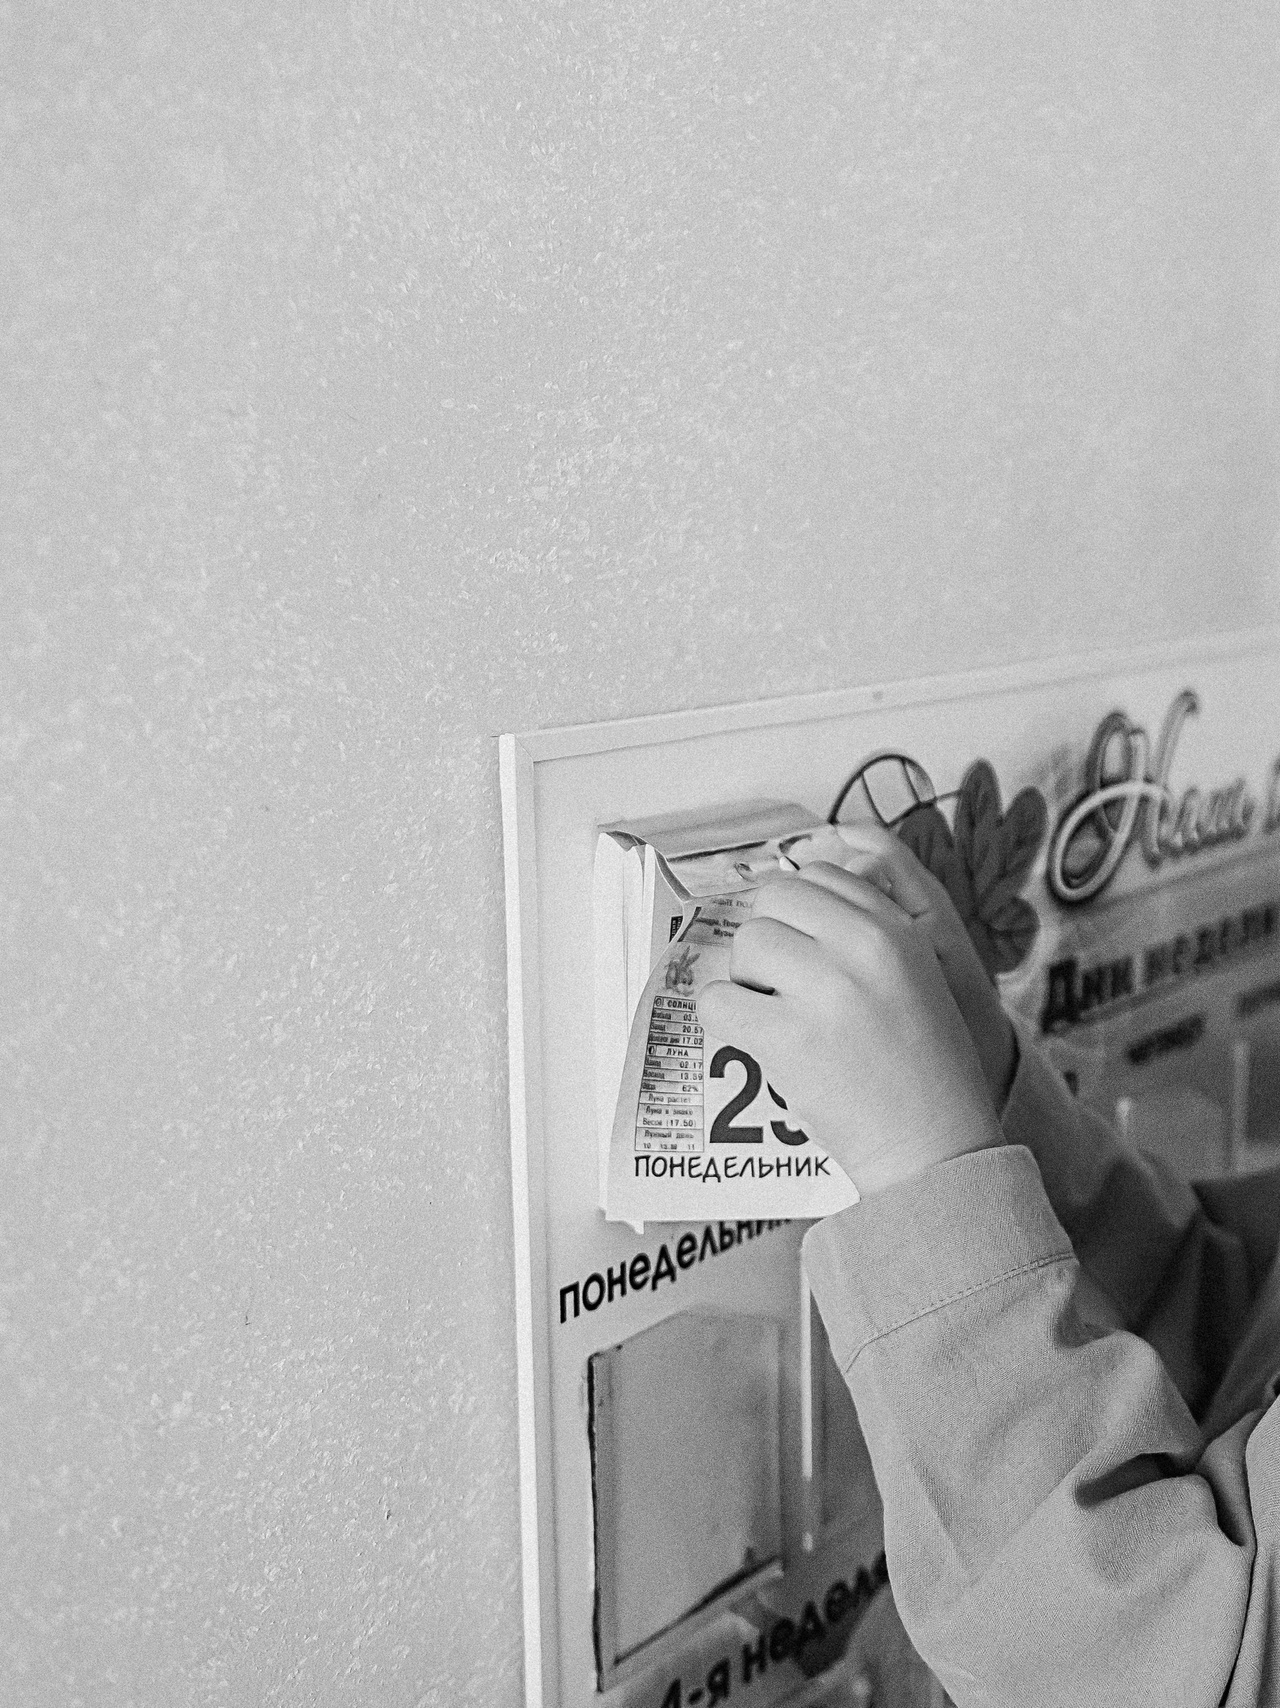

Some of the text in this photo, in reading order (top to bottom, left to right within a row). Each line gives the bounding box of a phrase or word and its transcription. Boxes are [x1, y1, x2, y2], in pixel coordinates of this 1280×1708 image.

[1042, 956, 1134, 1036] Дни
[666, 1048, 689, 1057] ЛУНА
[635, 1155, 831, 1183] ПОНЕДЕЛЬНИК
[559, 1219, 791, 1324] понедельн
